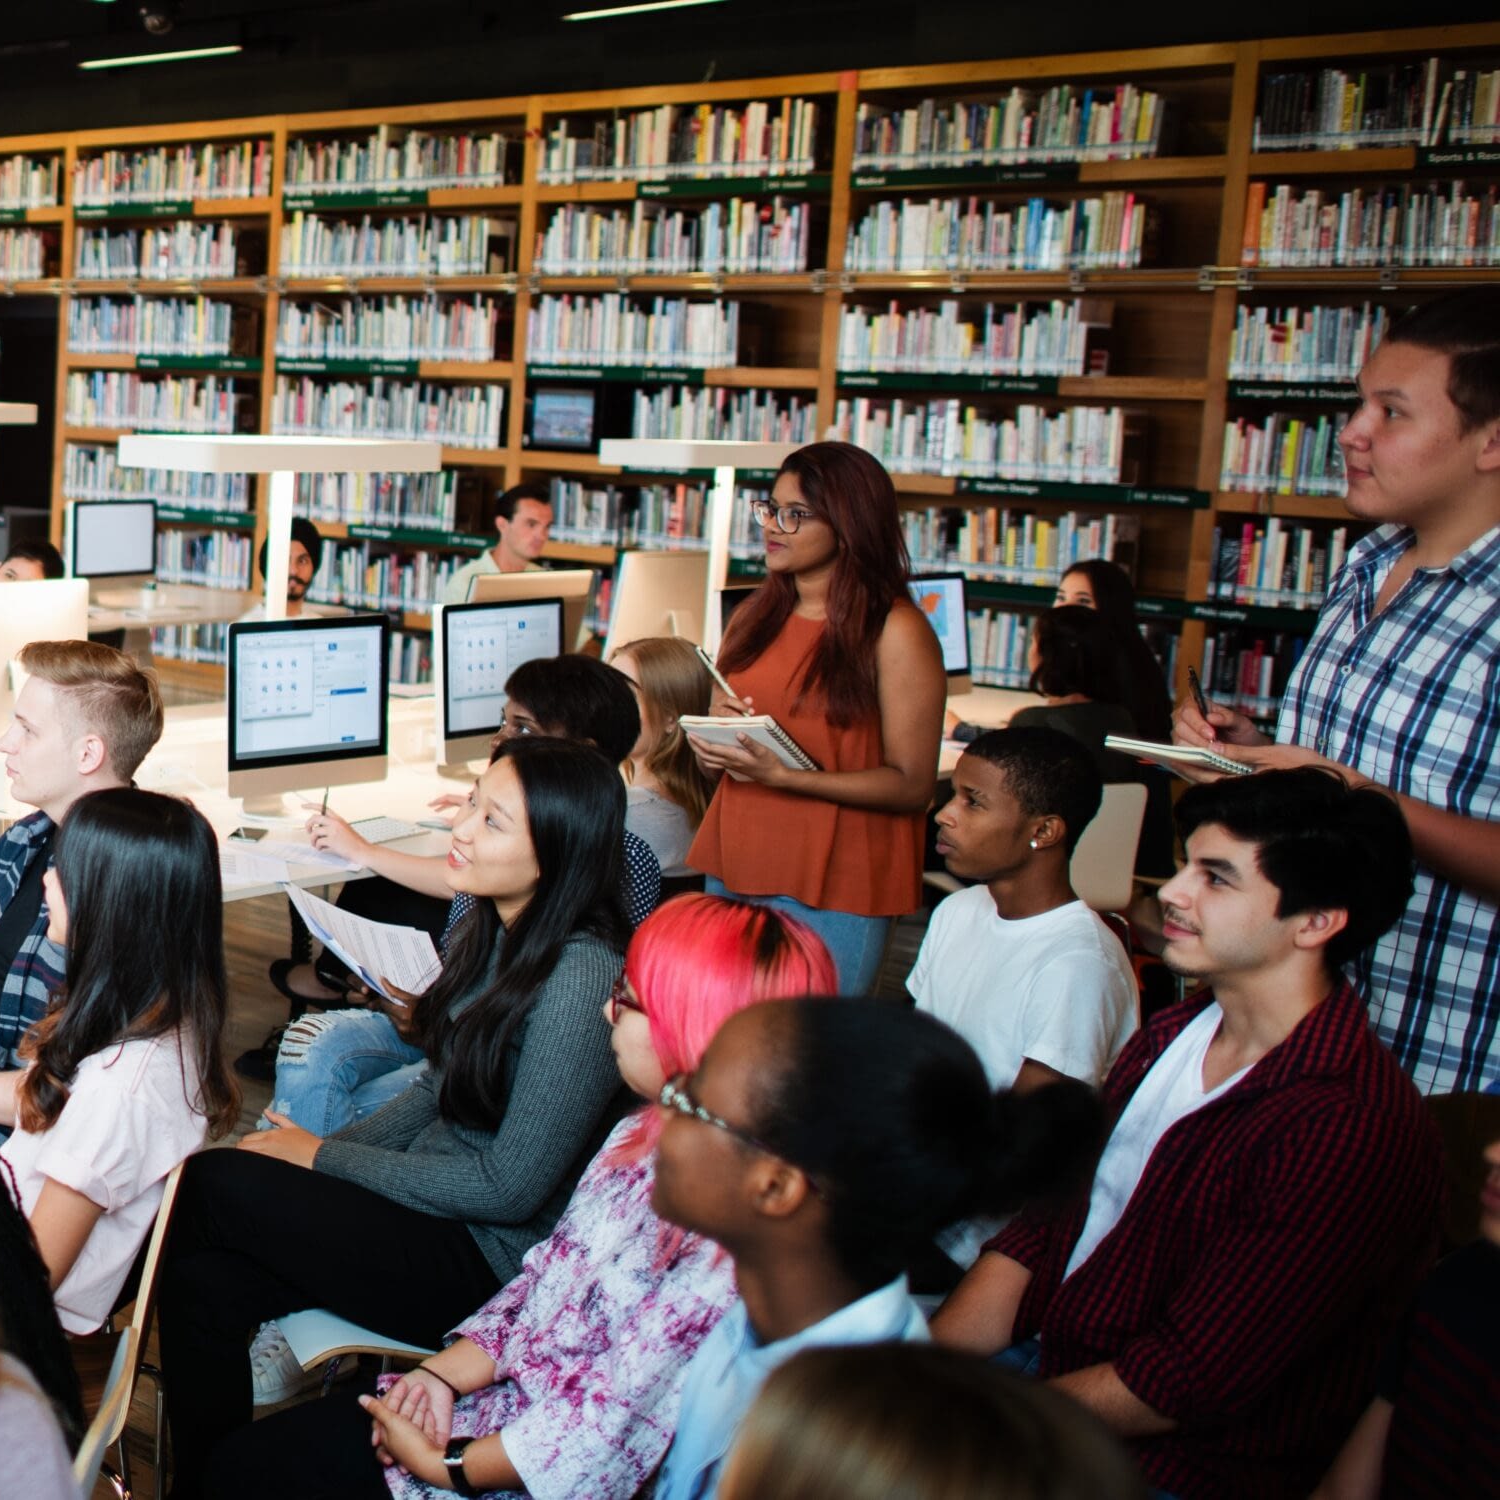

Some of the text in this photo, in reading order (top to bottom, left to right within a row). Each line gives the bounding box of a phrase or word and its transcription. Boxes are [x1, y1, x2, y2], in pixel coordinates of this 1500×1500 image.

[1428, 153, 1462, 163] Sports
[1466, 152, 1474, 161] &
[1237, 387, 1284, 398] Language
[1286, 389, 1306, 398] Arts
[1309, 389, 1316, 398] &
[1195, 606, 1247, 621] Philoophy
